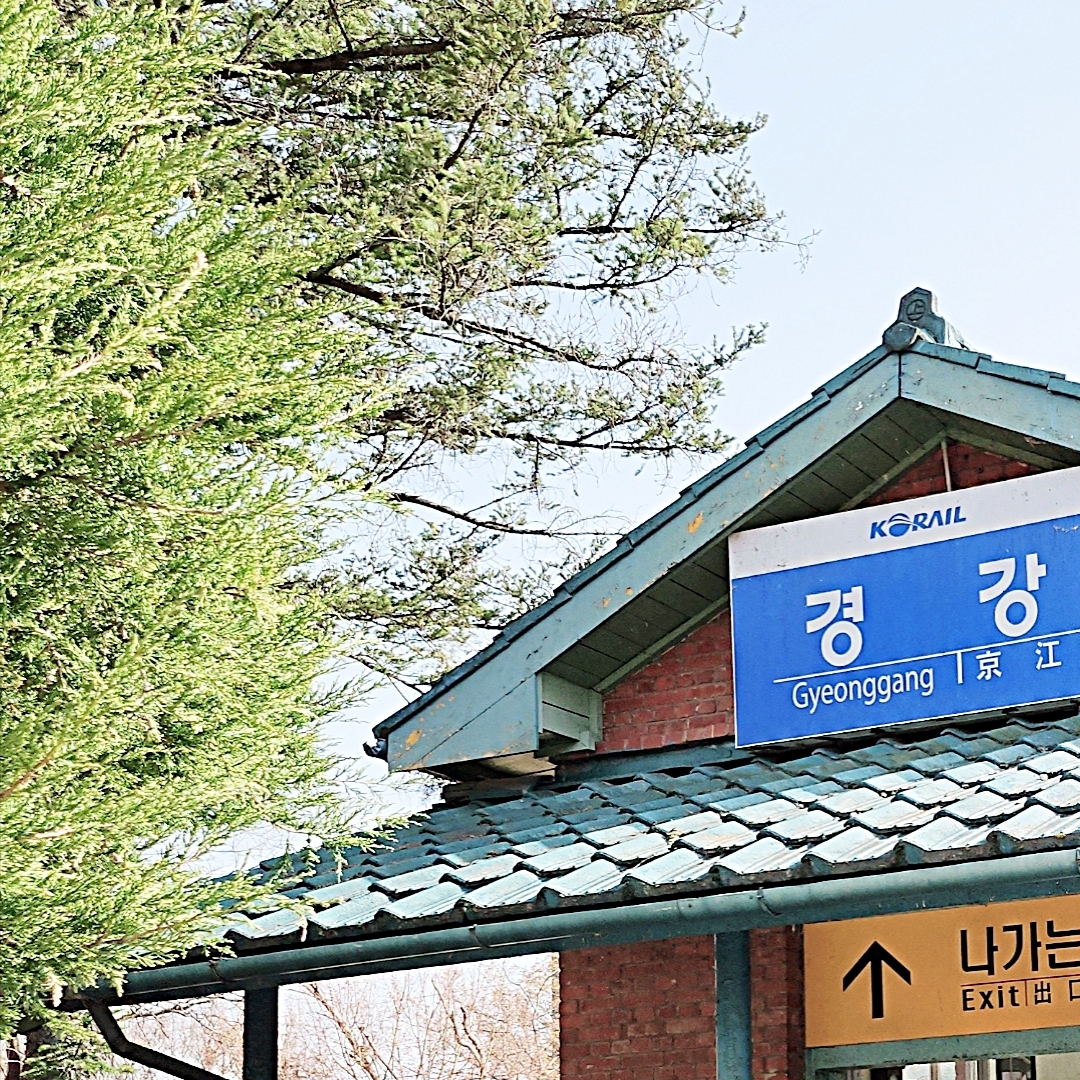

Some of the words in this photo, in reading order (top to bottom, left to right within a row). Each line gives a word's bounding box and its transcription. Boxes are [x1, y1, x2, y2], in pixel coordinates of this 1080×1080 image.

[870, 506, 966, 539] KORAIL
[791, 666, 934, 714] Gyeonggang
[962, 985, 1020, 1011] Exit
